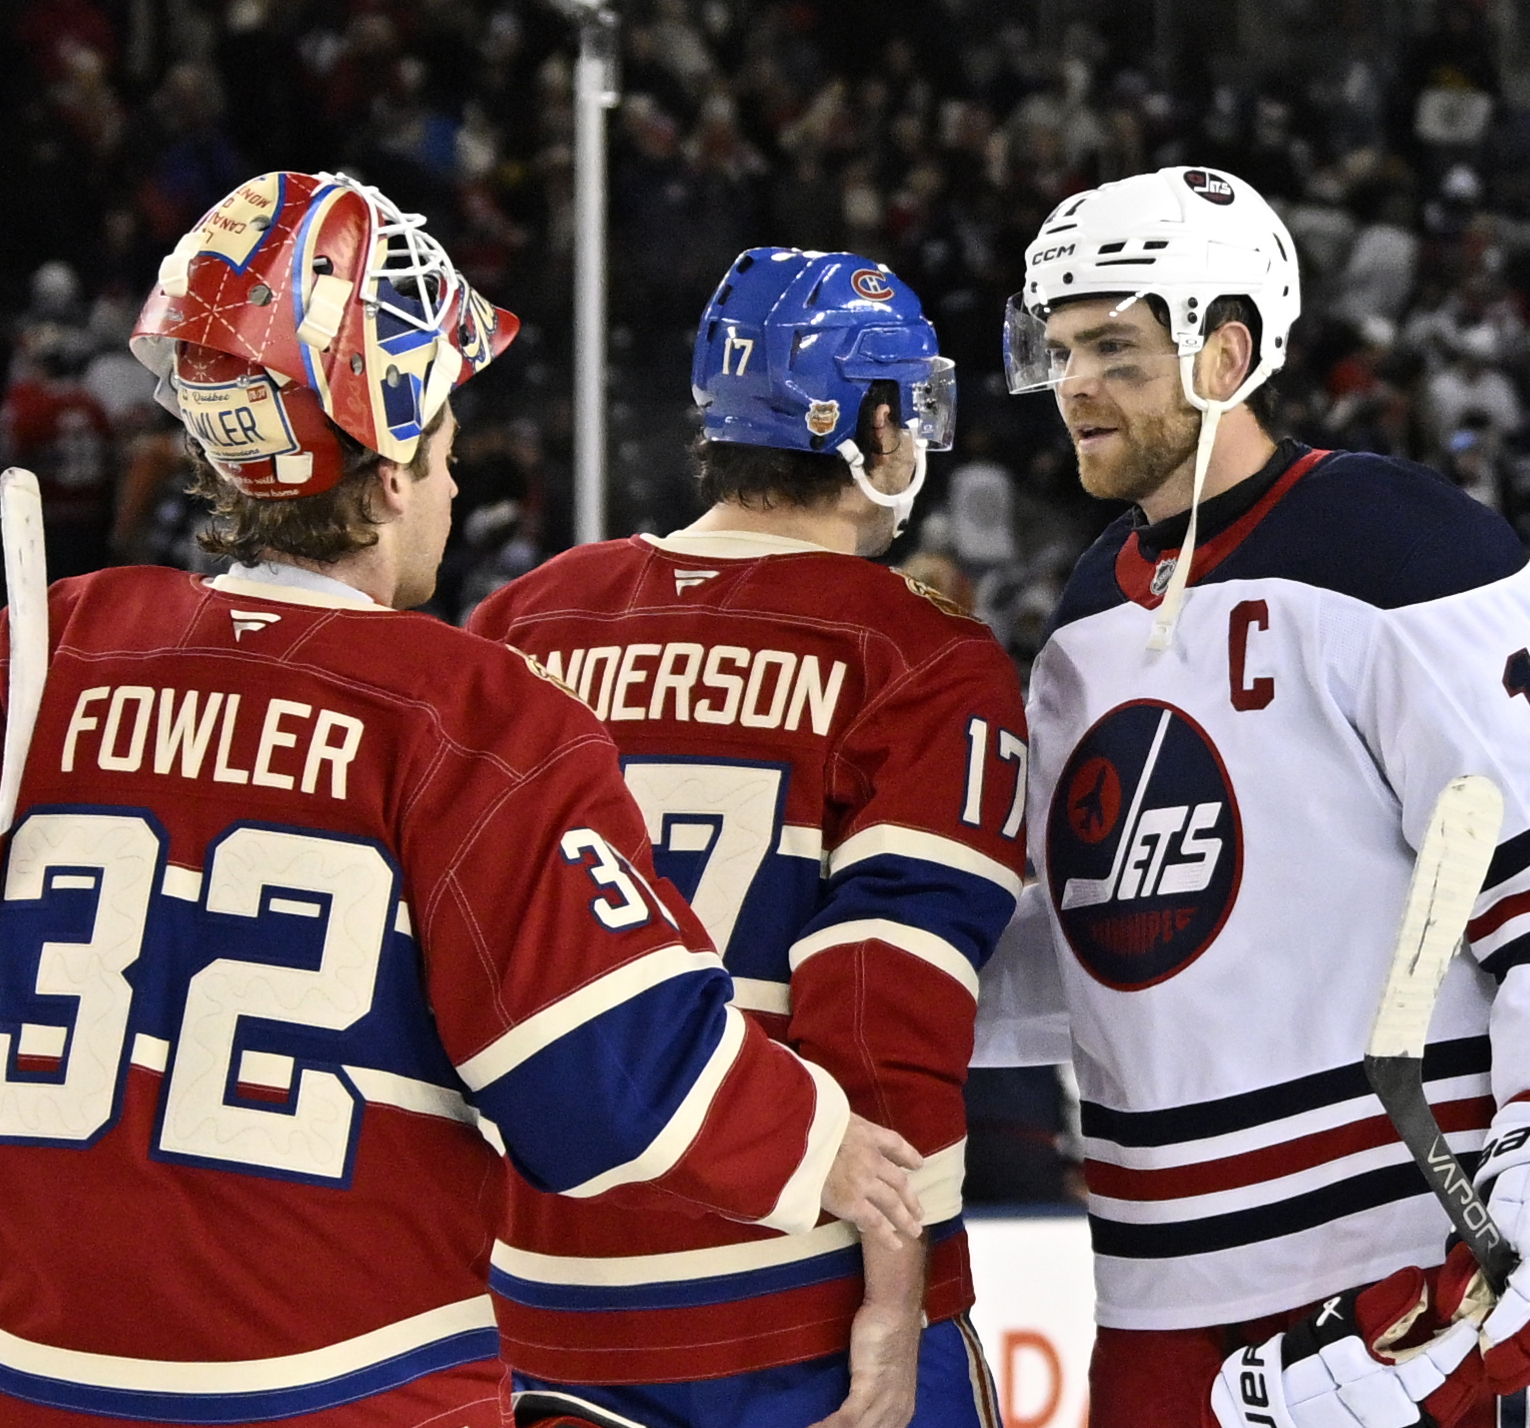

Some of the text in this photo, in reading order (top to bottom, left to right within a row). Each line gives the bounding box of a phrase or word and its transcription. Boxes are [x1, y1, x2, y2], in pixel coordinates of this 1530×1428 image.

[1031, 242, 1077, 267] CCM
[721, 337, 755, 378] 17
[528, 639, 848, 737] NDERSON
[1228, 599, 1275, 711] C
[61, 684, 366, 801] FOWLER
[966, 715, 1029, 843] 17
[556, 825, 682, 937] 3
[1426, 1135, 1502, 1253] VAPOR
